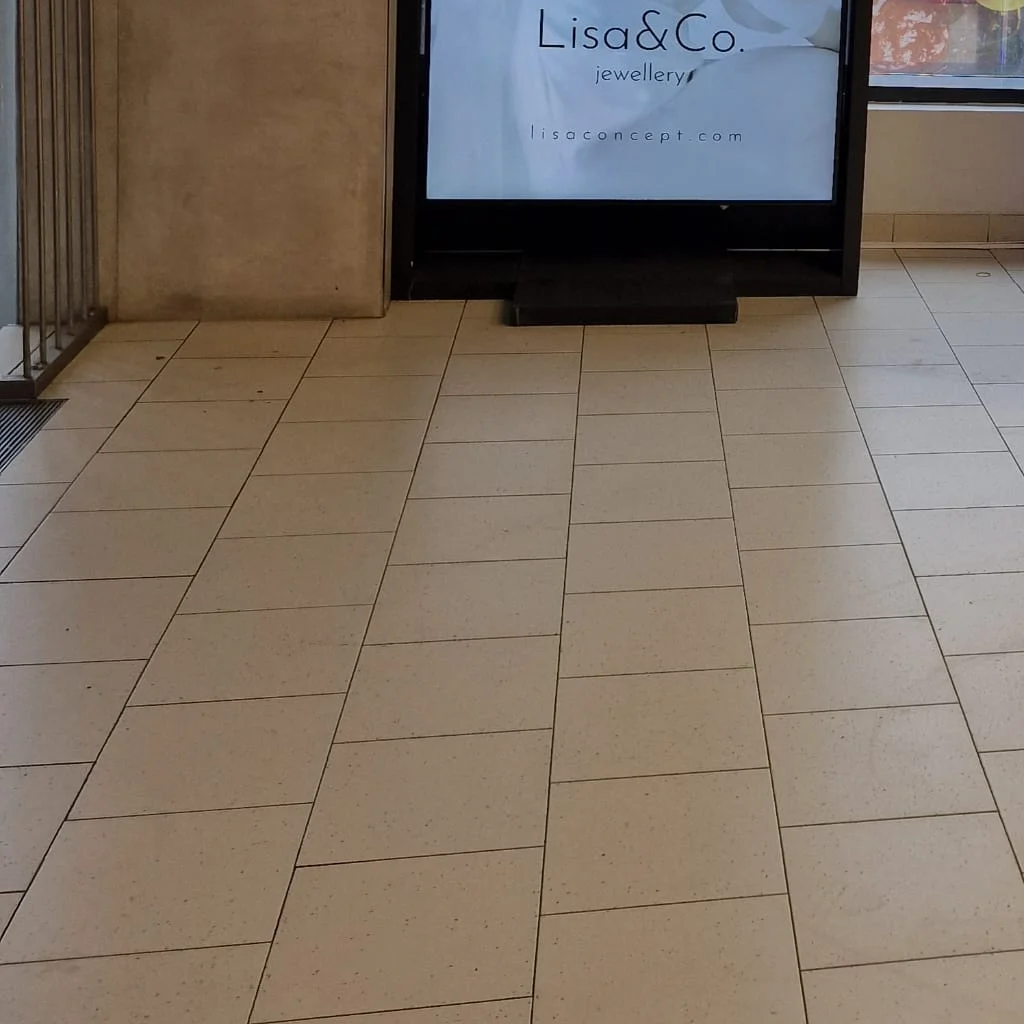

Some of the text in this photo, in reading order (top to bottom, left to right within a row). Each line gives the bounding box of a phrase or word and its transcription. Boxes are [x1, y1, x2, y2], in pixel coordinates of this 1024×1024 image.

[538, 8, 745, 53] Lisa&Co.
[595, 63, 685, 85] jewellery
[530, 124, 743, 144] lisaconcept.com
